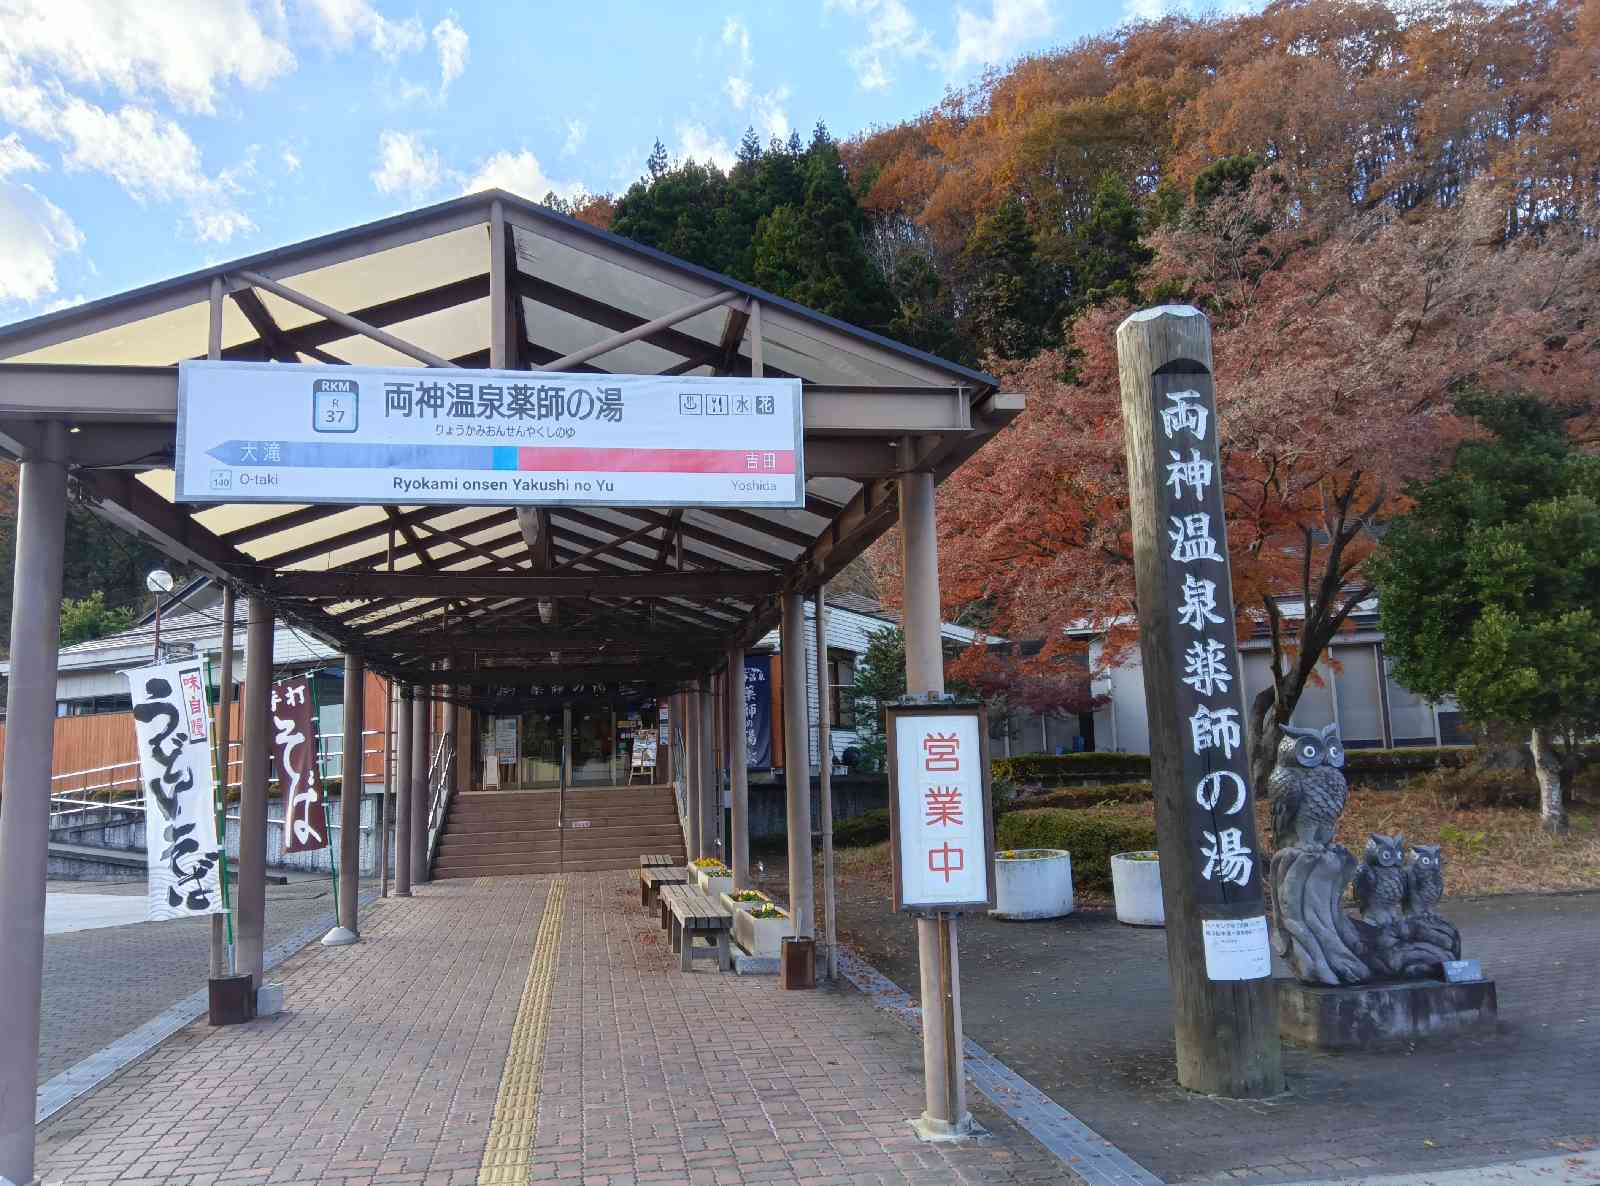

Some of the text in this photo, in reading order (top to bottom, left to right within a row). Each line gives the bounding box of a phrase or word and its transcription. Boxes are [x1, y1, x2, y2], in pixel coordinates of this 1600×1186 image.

[321, 381, 350, 392] RKM
[383, 381, 625, 422] 両神温泉薬師の湯
[325, 410, 345, 423] 37
[435, 423, 576, 439] りょうかみおんせんやくしのゆ
[240, 442, 281, 462] 大滝
[745, 452, 776, 470] 吉田
[240, 472, 279, 485] O-taki
[393, 476, 614, 493] Ryokami onsen Yakushi no Yu
[731, 479, 777, 491] Yoshida
[1160, 389, 1254, 888] 両神温泉薬師の湯
[182, 674, 205, 737] 味自慢
[273, 716, 322, 848] そば
[923, 732, 964, 883] 営業中
